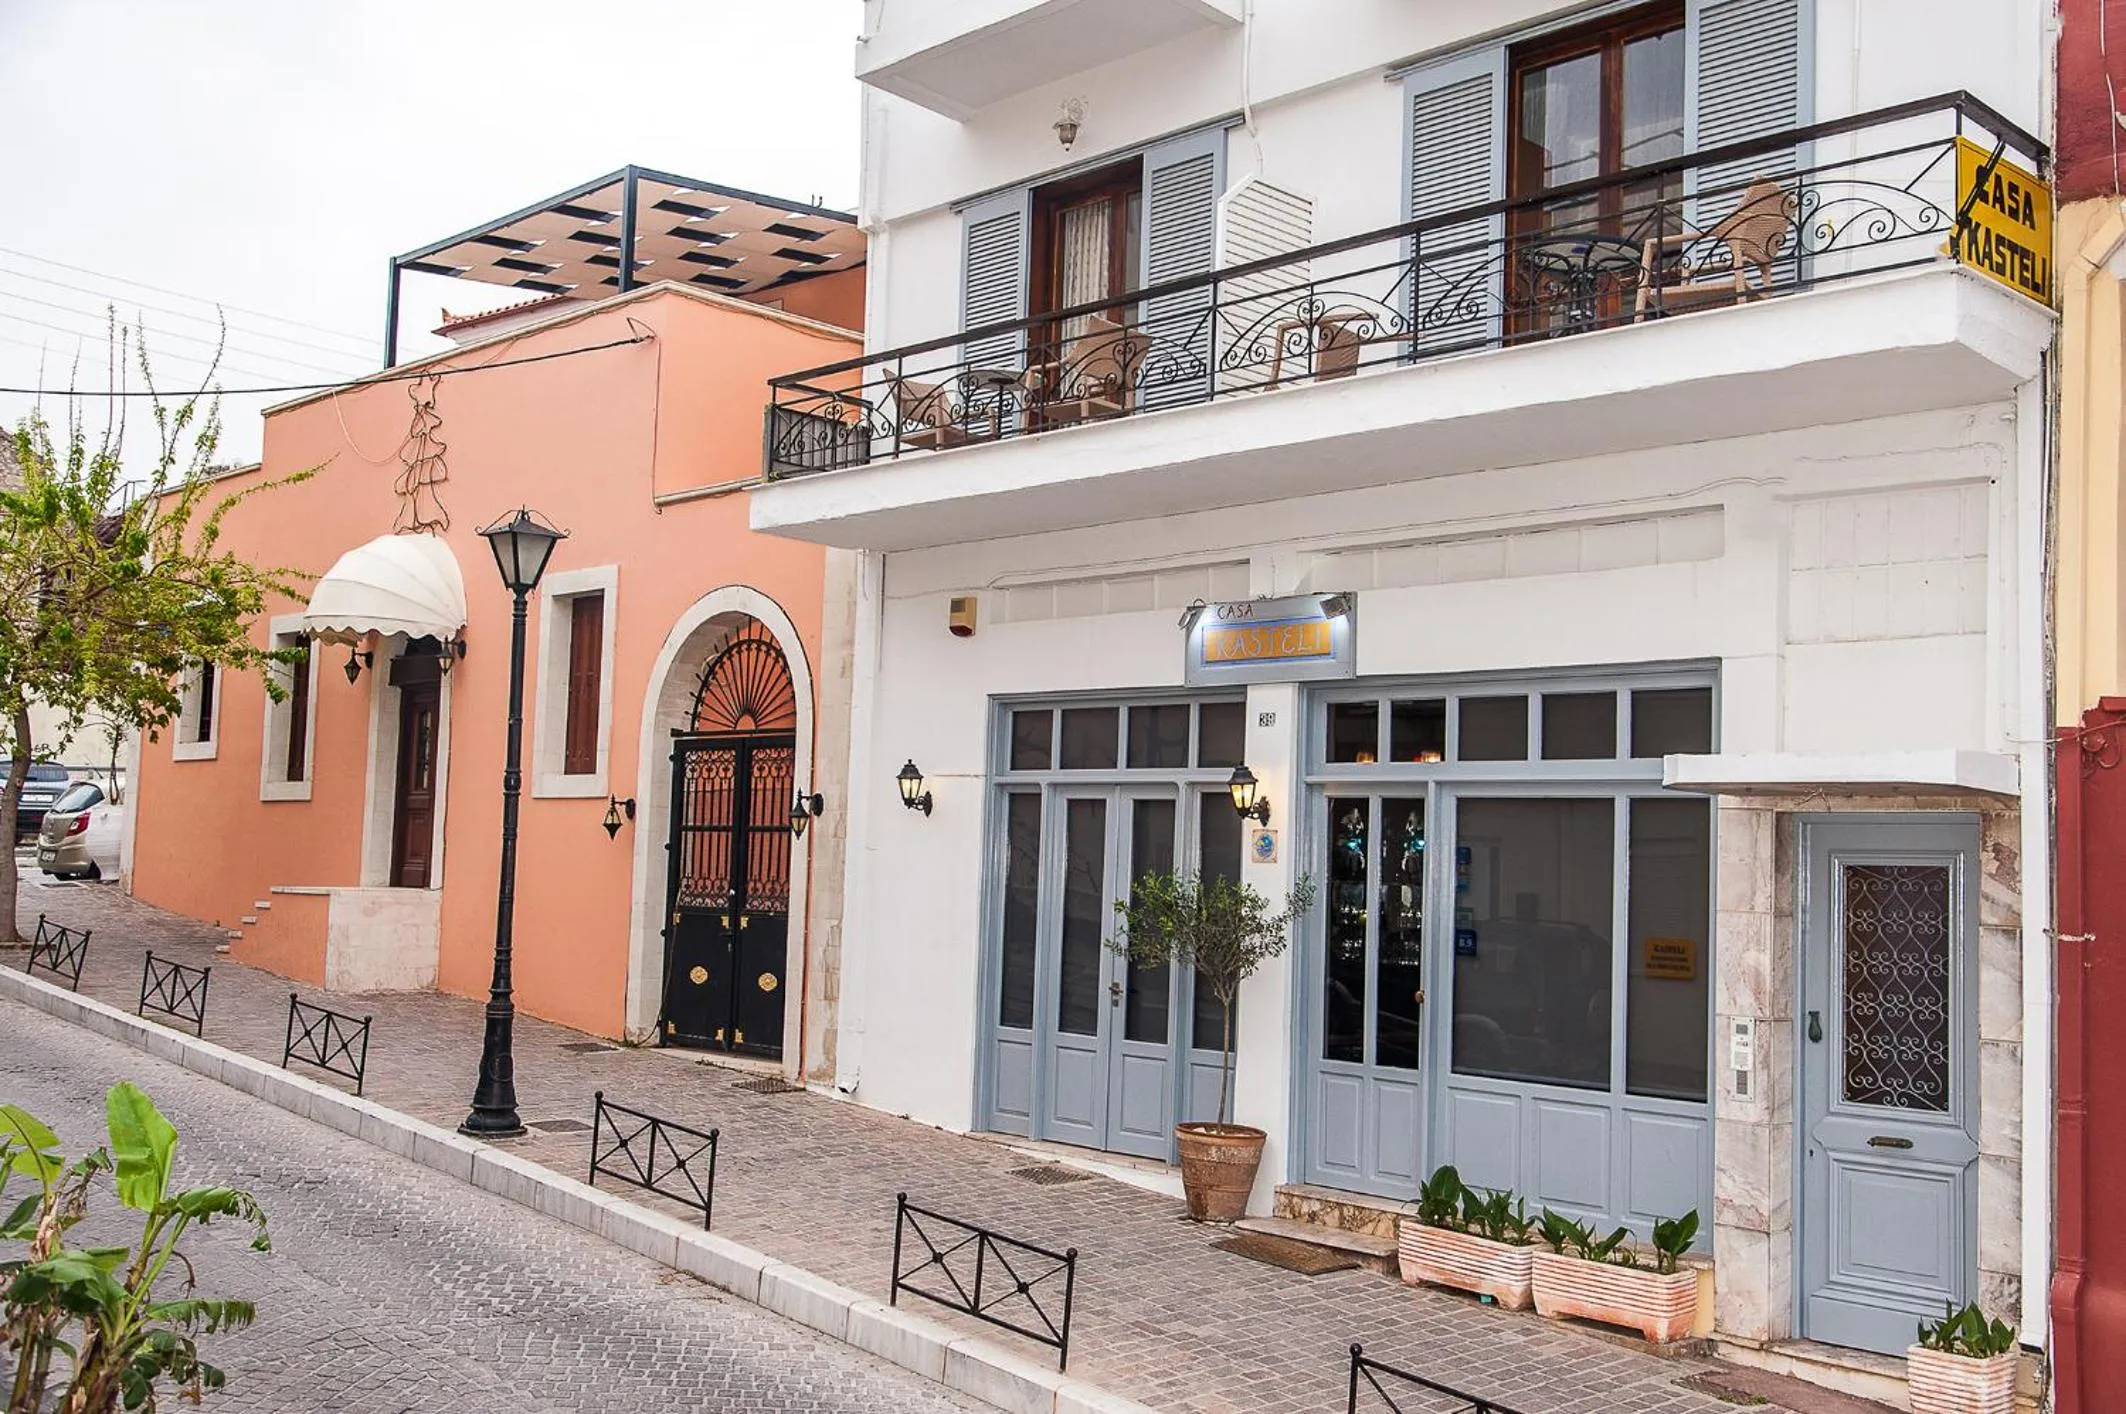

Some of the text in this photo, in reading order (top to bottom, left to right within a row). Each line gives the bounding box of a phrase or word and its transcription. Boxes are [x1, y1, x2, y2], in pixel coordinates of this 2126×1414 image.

[1966, 221, 2047, 298] KASTELI
[1216, 603, 1254, 620] CASA
[1215, 625, 1323, 659] KASTELI
